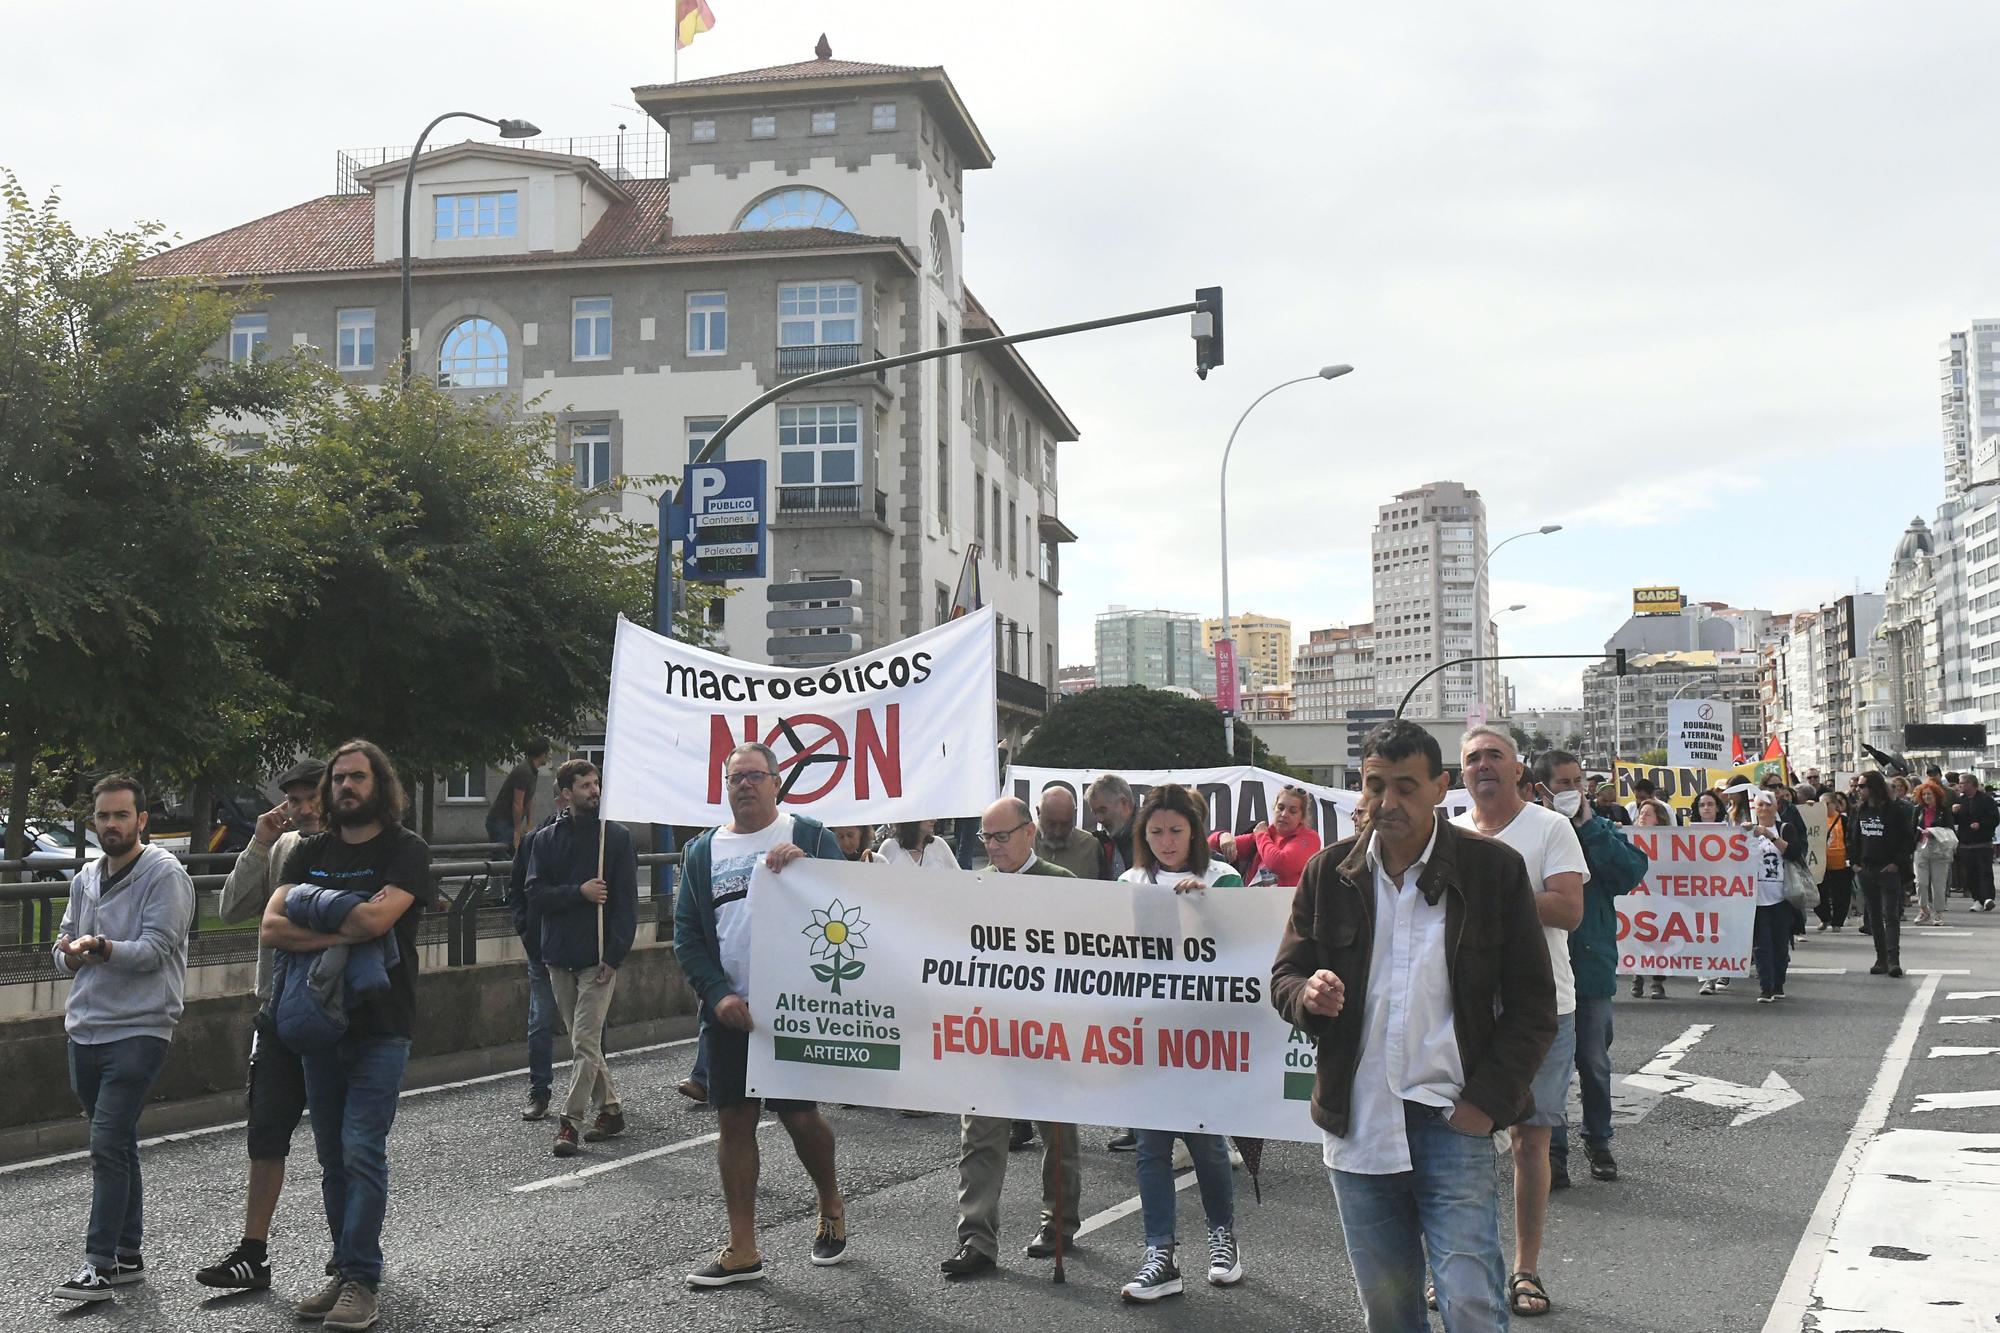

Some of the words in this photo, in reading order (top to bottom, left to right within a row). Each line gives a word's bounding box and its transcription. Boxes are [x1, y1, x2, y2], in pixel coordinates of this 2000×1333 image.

[692, 468, 726, 514] P
[710, 500, 752, 510] PÚBLICO
[702, 517, 744, 525] Cantones
[704, 547, 742, 556] Palexco
[1636, 590, 1677, 601] GADIS
[664, 652, 932, 701] macroeólicos
[1680, 731, 1686, 739] A
[1687, 731, 1710, 739] TERRA
[1711, 733, 1725, 742] PARA
[1690, 751, 1718, 761] ENERXIA
[1618, 768, 1708, 797] NON
[1671, 834, 1749, 862] NOS
[1656, 876, 1754, 897] TERRA!
[970, 925, 1017, 953] QUE
[1026, 929, 1055, 954] SE
[1064, 931, 1174, 961] DECATEN
[1183, 937, 1217, 963] OS
[1623, 955, 1636, 968] O
[1641, 955, 1702, 970] MONTE
[922, 956, 1046, 992] POLÍTICOS
[1054, 968, 1262, 1004] INCOMPETENTES
[775, 992, 896, 1020] Alternativa
[773, 1014, 811, 1034] dos
[815, 1017, 901, 1041] Veciños
[932, 1006, 1071, 1062] ¡EÓLICA
[1081, 1017, 1144, 1066] ASÍ
[1158, 1028, 1250, 1073] NON!
[803, 1044, 871, 1063] ARTEIXO
